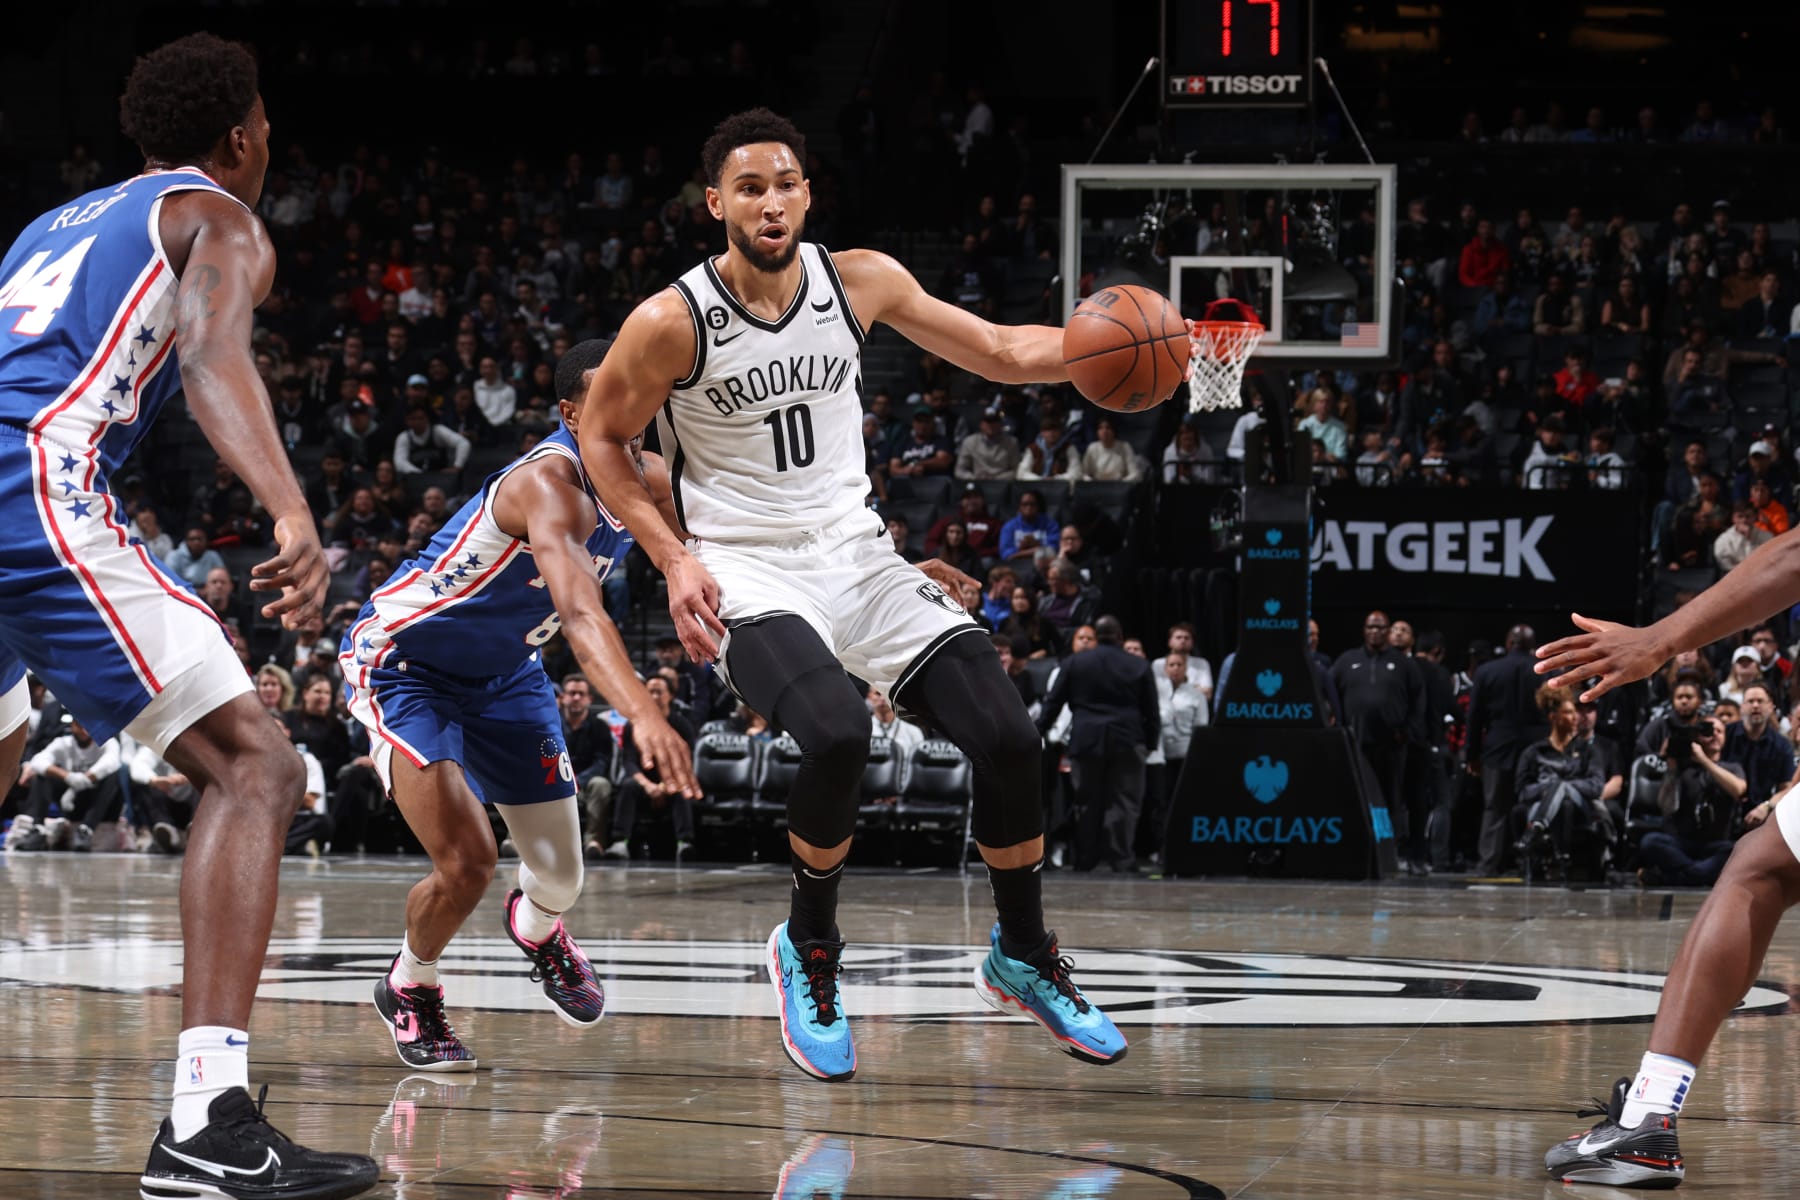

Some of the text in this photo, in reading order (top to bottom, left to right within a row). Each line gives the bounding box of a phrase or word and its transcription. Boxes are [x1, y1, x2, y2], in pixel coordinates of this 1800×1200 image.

[1222, 0, 1280, 56] 17
[1206, 75, 1303, 94] TISSOT
[710, 309, 726, 327] 6
[815, 313, 839, 326] Webull
[704, 354, 852, 417] BROOKLYN
[763, 403, 815, 473] 10
[1248, 548, 1300, 559] BARCLAYS
[1310, 515, 1556, 582] ATGEEK
[525, 611, 561, 647] 8
[1246, 618, 1299, 629] BARCLAYS
[1226, 703, 1313, 719] BARCLAYS
[541, 751, 574, 785] 76
[1191, 816, 1343, 844] BARCLAYS
